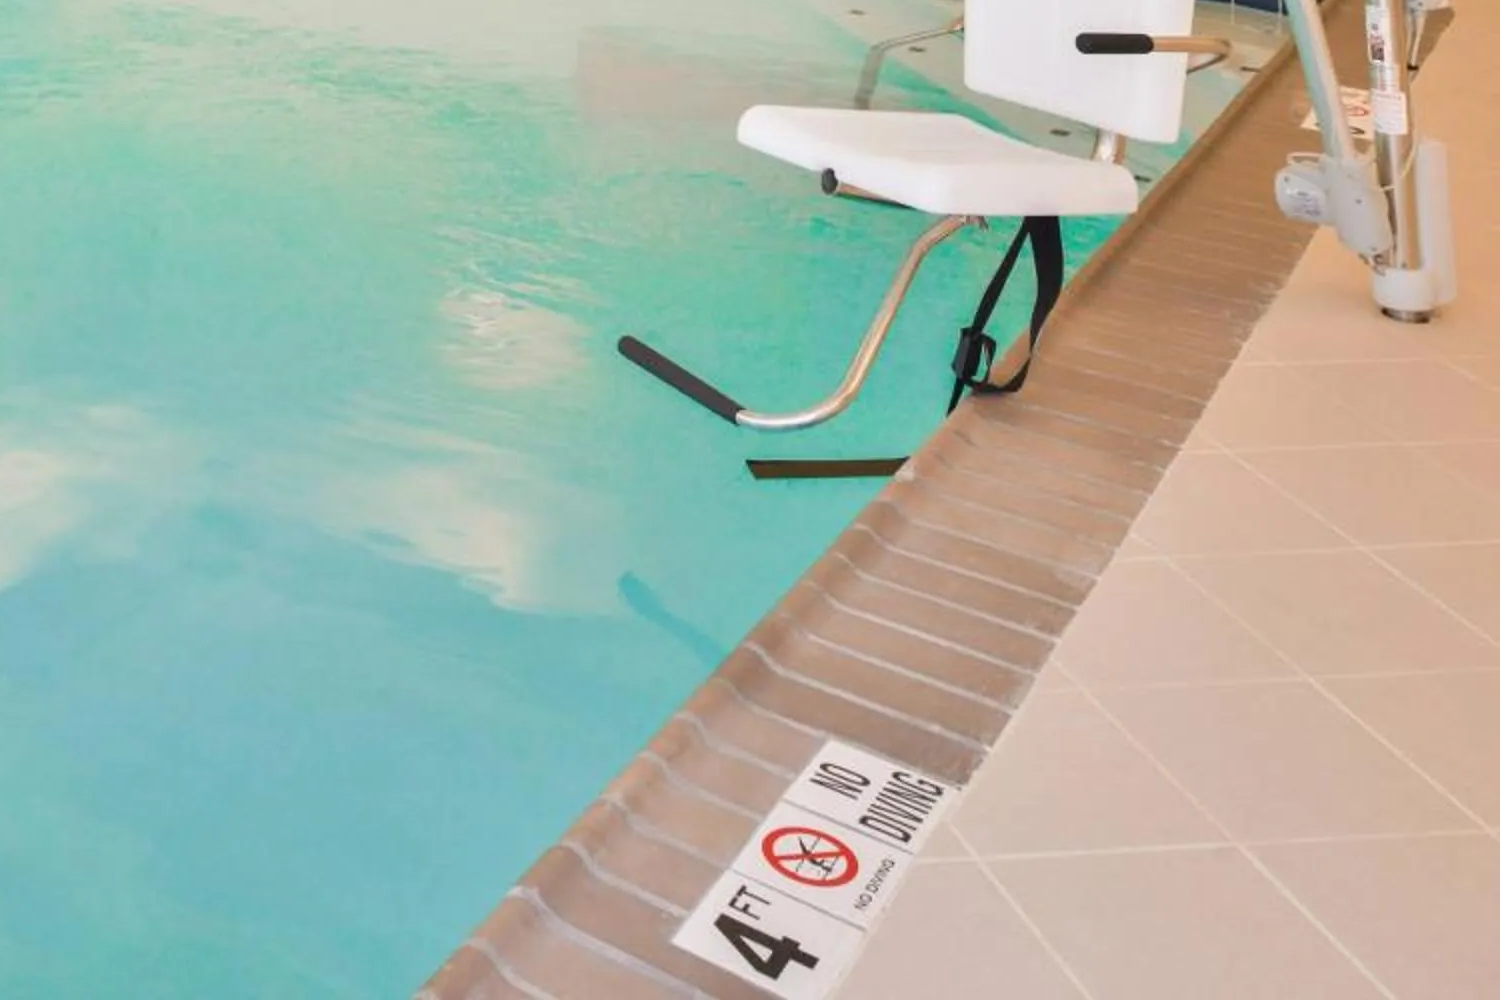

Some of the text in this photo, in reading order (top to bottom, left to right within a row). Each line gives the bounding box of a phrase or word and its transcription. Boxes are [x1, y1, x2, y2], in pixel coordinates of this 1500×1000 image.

[810, 762, 871, 801] NO
[858, 771, 945, 844] DIVING
[854, 858, 895, 911] NO DIVING
[713, 884, 820, 981] 4 FT
